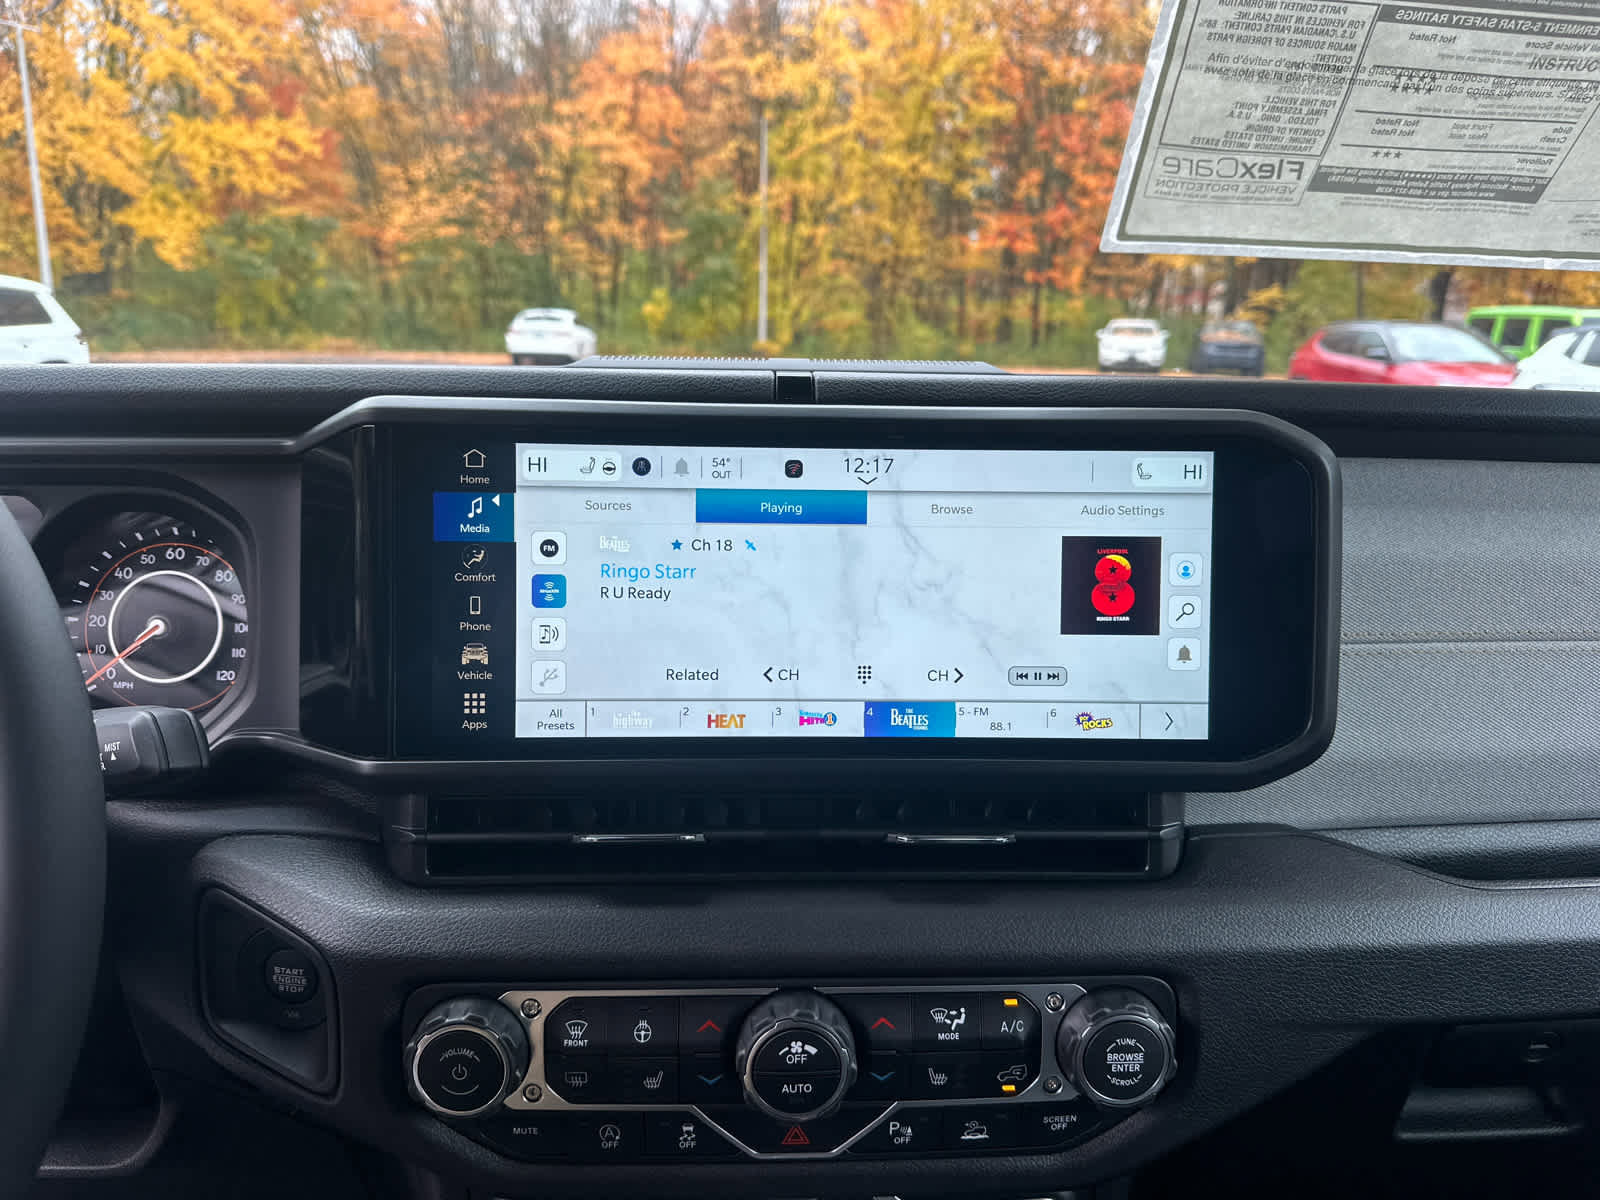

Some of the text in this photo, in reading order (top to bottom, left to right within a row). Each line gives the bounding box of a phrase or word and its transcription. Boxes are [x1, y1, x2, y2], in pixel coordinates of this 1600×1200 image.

[1208, 52, 1230, 64] Afin
[1445, 83, 1463, 93] des
[528, 457, 548, 473] HI
[843, 458, 894, 474] 12:17
[712, 470, 732, 479] OUT
[1184, 464, 1202, 480] HI
[460, 475, 490, 485] Home
[585, 500, 632, 511] Sources
[760, 502, 803, 516] Playing
[931, 504, 973, 515] Browse
[1081, 504, 1165, 519] Audio Settings
[460, 523, 490, 534] Media
[691, 538, 733, 552] Ch 18
[165, 548, 185, 560] 60
[140, 555, 156, 564] 50
[196, 556, 210, 566] 70
[115, 567, 133, 579] 40
[215, 570, 232, 582] 80
[454, 572, 497, 583] Comfort
[600, 563, 697, 583] Ringo Starr
[100, 591, 114, 601] 30
[231, 594, 245, 604] 90
[600, 587, 671, 601] R U Ready
[88, 615, 107, 627] 20
[459, 622, 491, 632] Phone
[95, 645, 106, 654] 10
[231, 648, 246, 658] 110
[106, 668, 116, 679] 0
[216, 670, 236, 681] 120
[457, 671, 493, 681] Vehicle
[666, 668, 719, 681] Related
[778, 669, 800, 681] CH
[927, 670, 949, 682] CH
[113, 682, 134, 690] MPH
[549, 708, 563, 718] All
[683, 707, 689, 716] 2
[775, 707, 782, 716] 3
[866, 707, 873, 716] 4
[958, 707, 989, 716] 5 FM
[1050, 708, 1057, 717] 6
[707, 714, 746, 729] HEAT
[890, 708, 929, 728] BEATLES
[462, 720, 488, 731] Apps
[537, 720, 575, 730] Presets
[990, 722, 1012, 731] 88.1
[1083, 718, 1113, 731] ROCKS
[104, 741, 121, 752] MIST
[274, 966, 304, 976] START
[273, 974, 307, 985] ENGINE
[279, 985, 304, 993] STOP
[1000, 1021, 1025, 1032] A/C
[938, 1032, 960, 1040] MODE
[564, 1039, 588, 1047] FRONT
[1116, 1038, 1137, 1047] TUNE
[443, 1049, 475, 1059] VOLUME
[786, 1054, 808, 1064] OFF
[1106, 1052, 1144, 1062] BROWSE
[1111, 1063, 1140, 1073] ENTER
[1110, 1077, 1138, 1086] SCROLL
[781, 1083, 813, 1094] AUTO
[1043, 1115, 1077, 1124] SCREEN
[513, 1127, 538, 1135] MUTE
[889, 1122, 900, 1134] P
[1051, 1122, 1067, 1131] OFF
[601, 1141, 619, 1149] OFF
[679, 1141, 696, 1149] OFF
[894, 1137, 911, 1145] OFF
